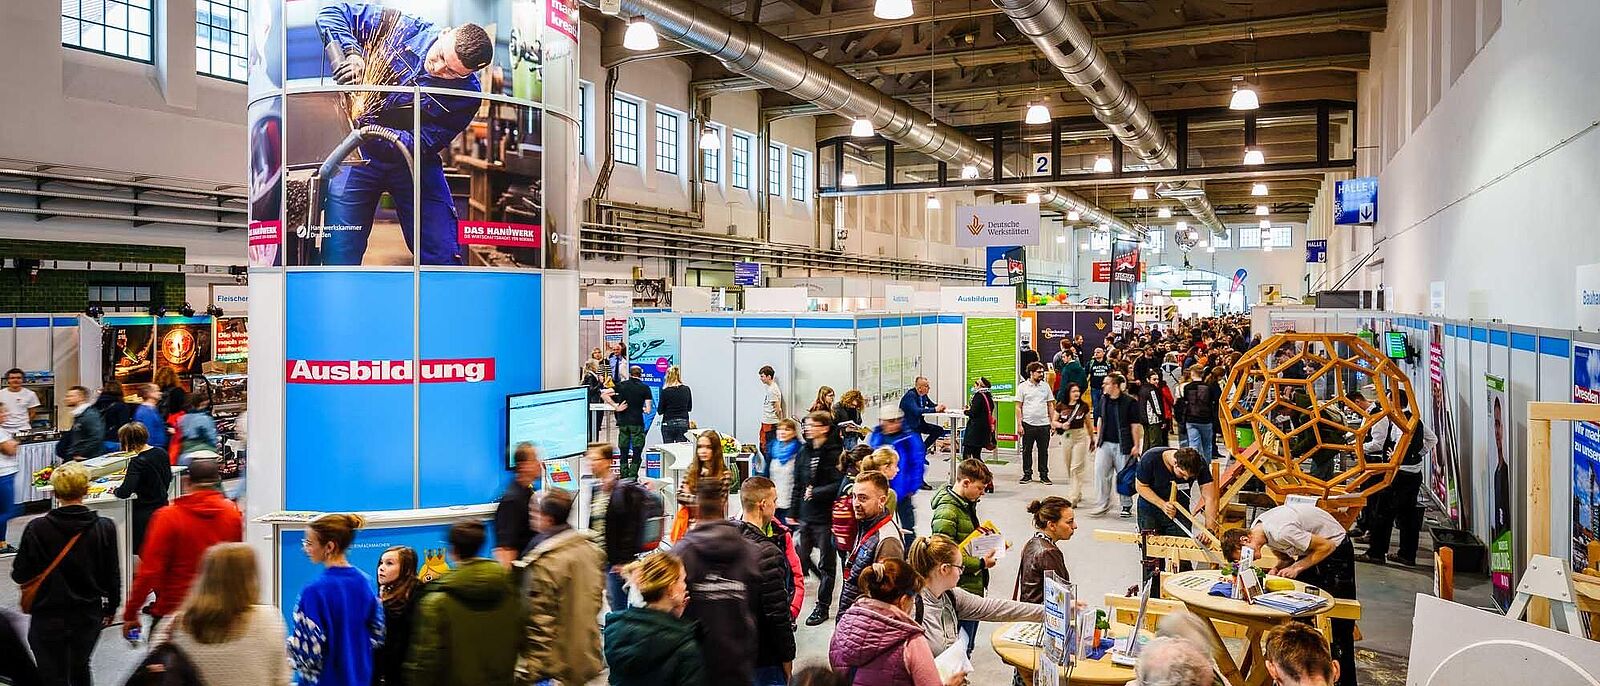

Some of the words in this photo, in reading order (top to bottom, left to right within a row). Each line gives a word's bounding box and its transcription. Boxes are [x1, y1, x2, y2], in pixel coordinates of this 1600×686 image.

[1036, 156, 1048, 173] 2
[1338, 183, 1368, 194] HALLE
[310, 224, 362, 232] Hanwerkskammer
[988, 221, 1020, 229] Deutsche
[463, 226, 485, 235] DAS
[487, 226, 534, 238] HANDWERK
[988, 228, 1029, 236] Werkstätten
[957, 294, 999, 304] Ausbildung
[291, 359, 485, 383] Ausbildung
[1574, 384, 1599, 404] Dresden
[1575, 420, 1585, 436] Wir
[1574, 441, 1582, 453] zu
